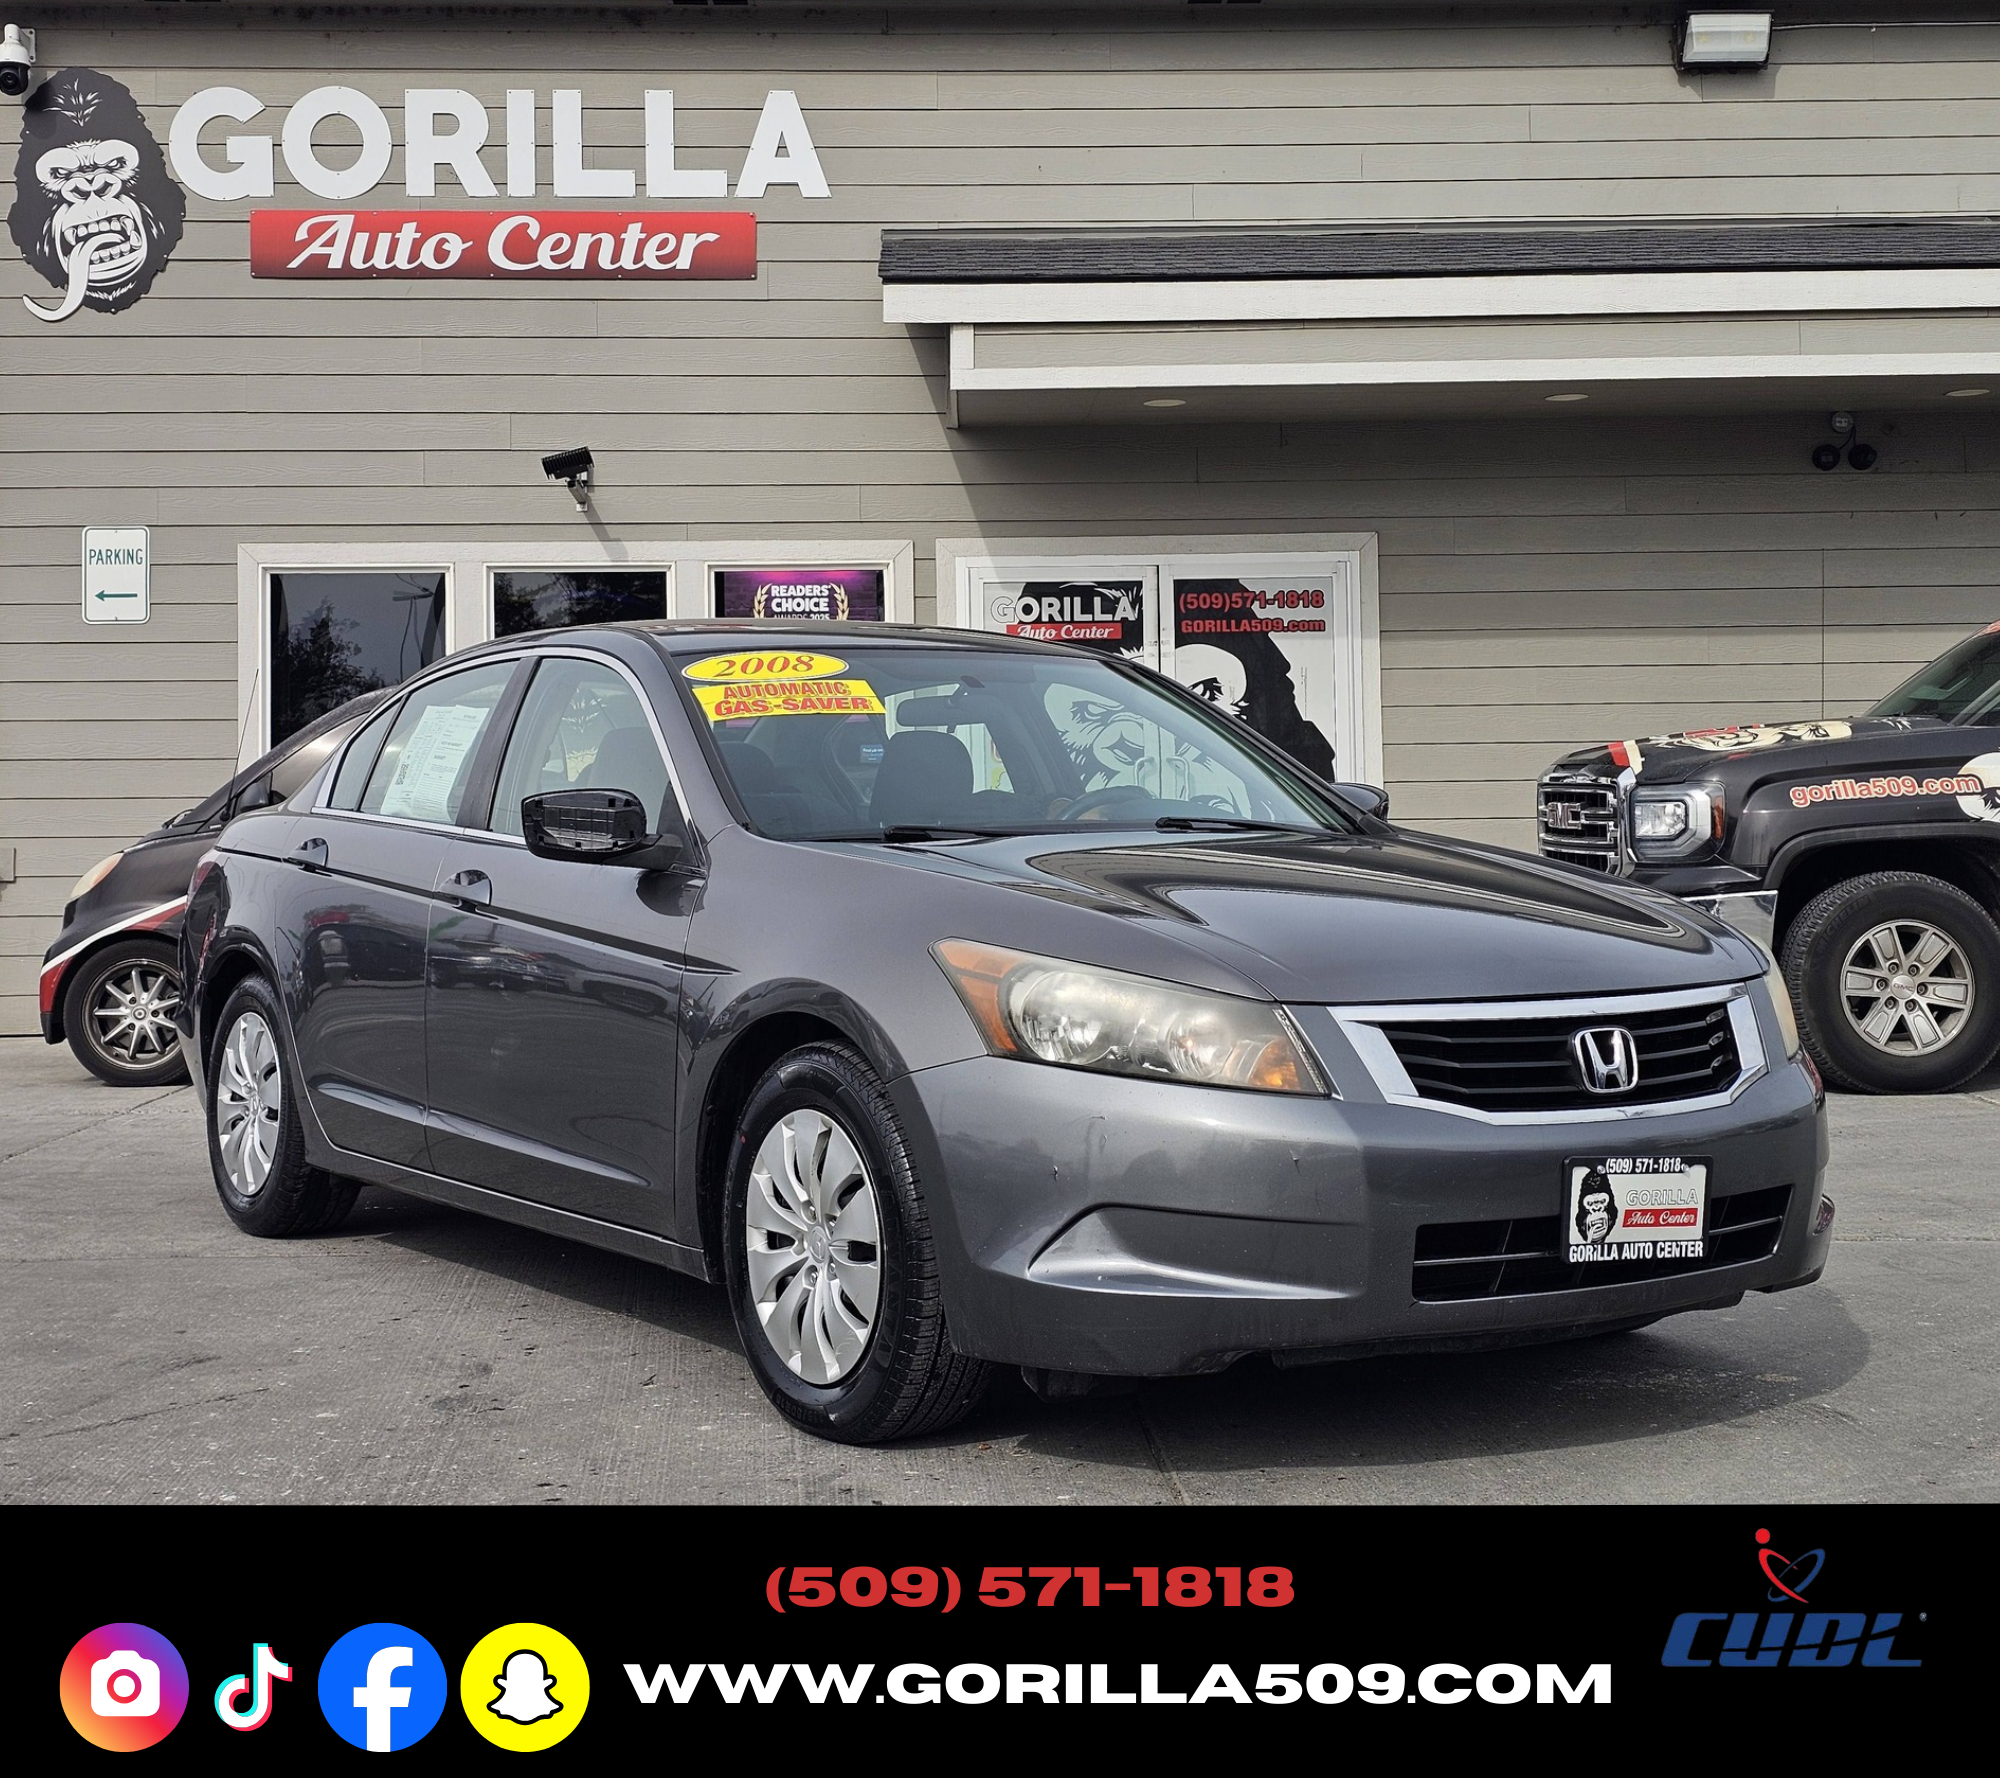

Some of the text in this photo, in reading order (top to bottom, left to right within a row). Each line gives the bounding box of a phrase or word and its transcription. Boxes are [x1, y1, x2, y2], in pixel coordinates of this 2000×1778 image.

[169, 86, 832, 200] GORILLA
[286, 214, 720, 271] Auto Center
[89, 548, 143, 565] PARKING
[771, 585, 831, 596] READERS'
[771, 598, 829, 612] CHOICE
[990, 595, 1136, 623] GORILLA
[1179, 590, 1325, 613] (509)571-1818
[1017, 624, 1114, 640] Auto Center
[1181, 617, 1326, 633] GORILLA509.com
[713, 655, 815, 678] 2008
[723, 681, 852, 700] AUTOMATIC
[714, 697, 875, 717] GAS-SAVER
[1790, 775, 1984, 807] gorilla509.com
[1606, 1157, 1682, 1174] (509) 571-1818
[1626, 1189, 1699, 1206] GORILLA
[1627, 1210, 1696, 1225] Auto Center
[1569, 1241, 1704, 1263] GORILLA AUTO CENTER
